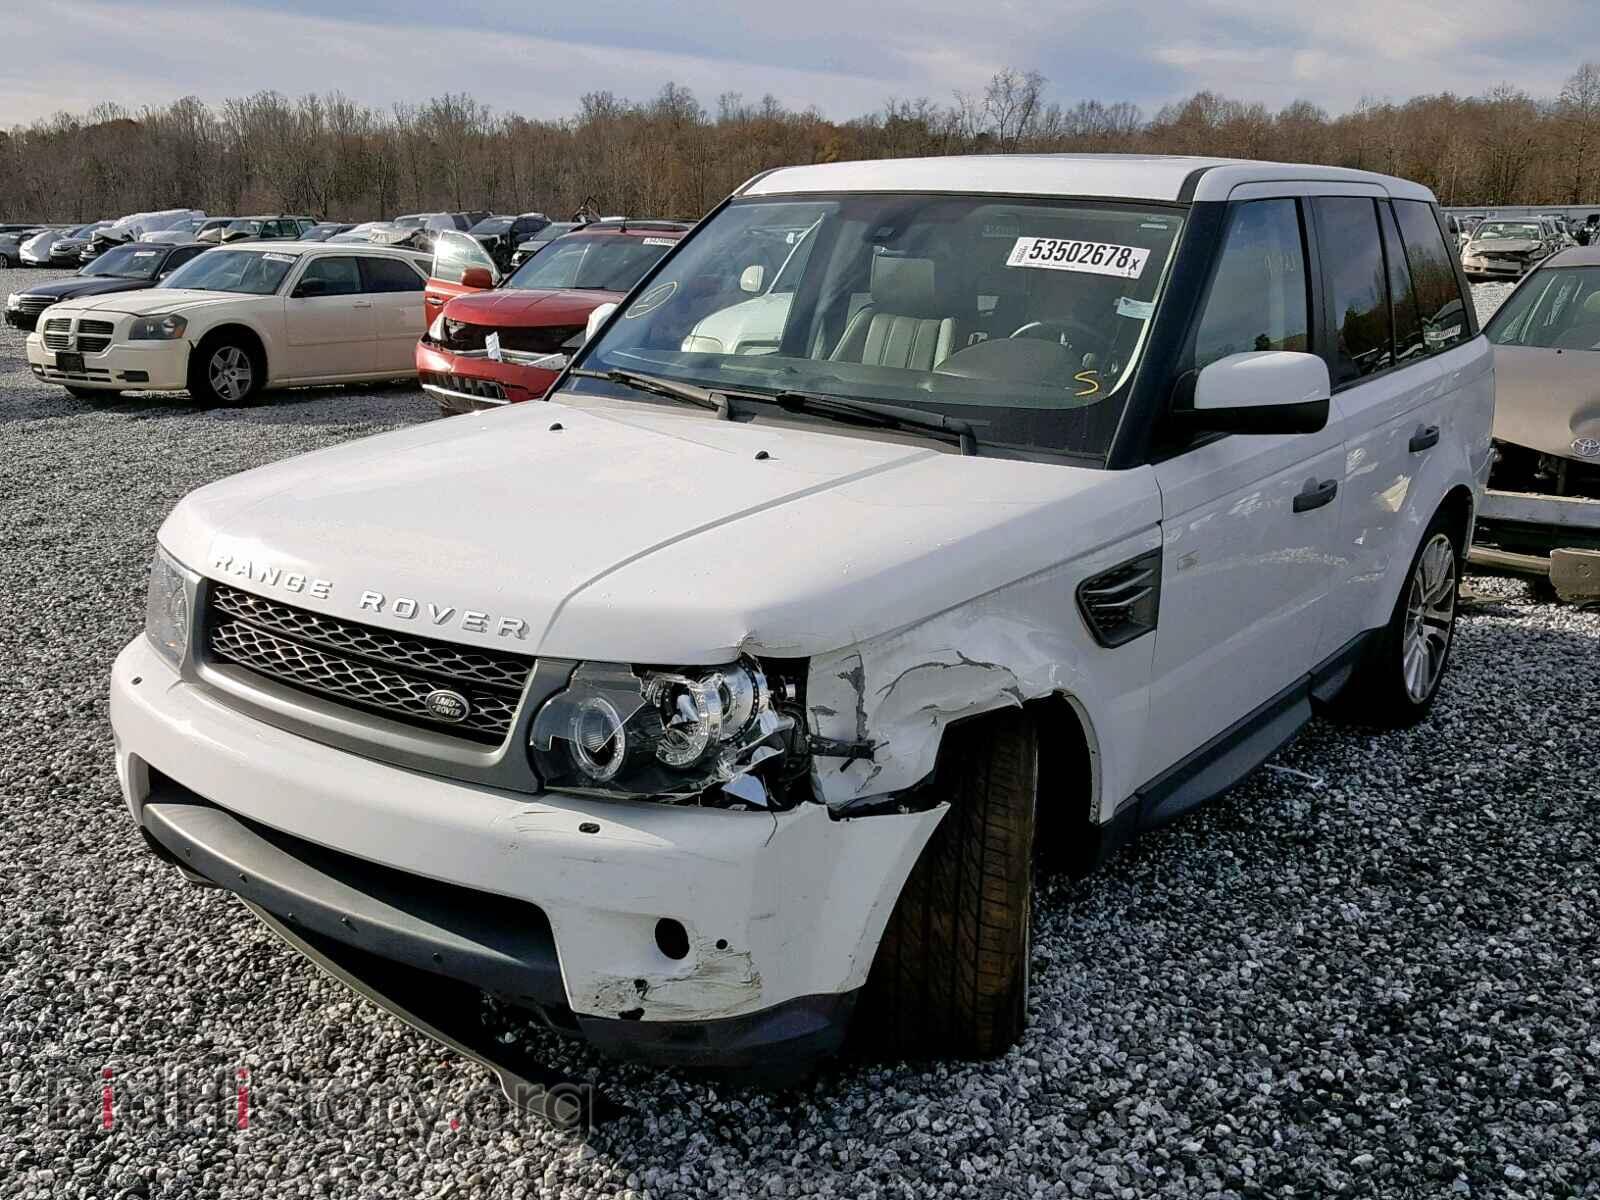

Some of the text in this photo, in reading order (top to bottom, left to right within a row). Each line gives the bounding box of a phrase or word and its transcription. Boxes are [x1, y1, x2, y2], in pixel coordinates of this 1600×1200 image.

[1028, 239, 1132, 268] 53502678
[213, 554, 530, 639] RANGE ROVER
[435, 696, 456, 707] LAND
[435, 704, 461, 717] ROVER
